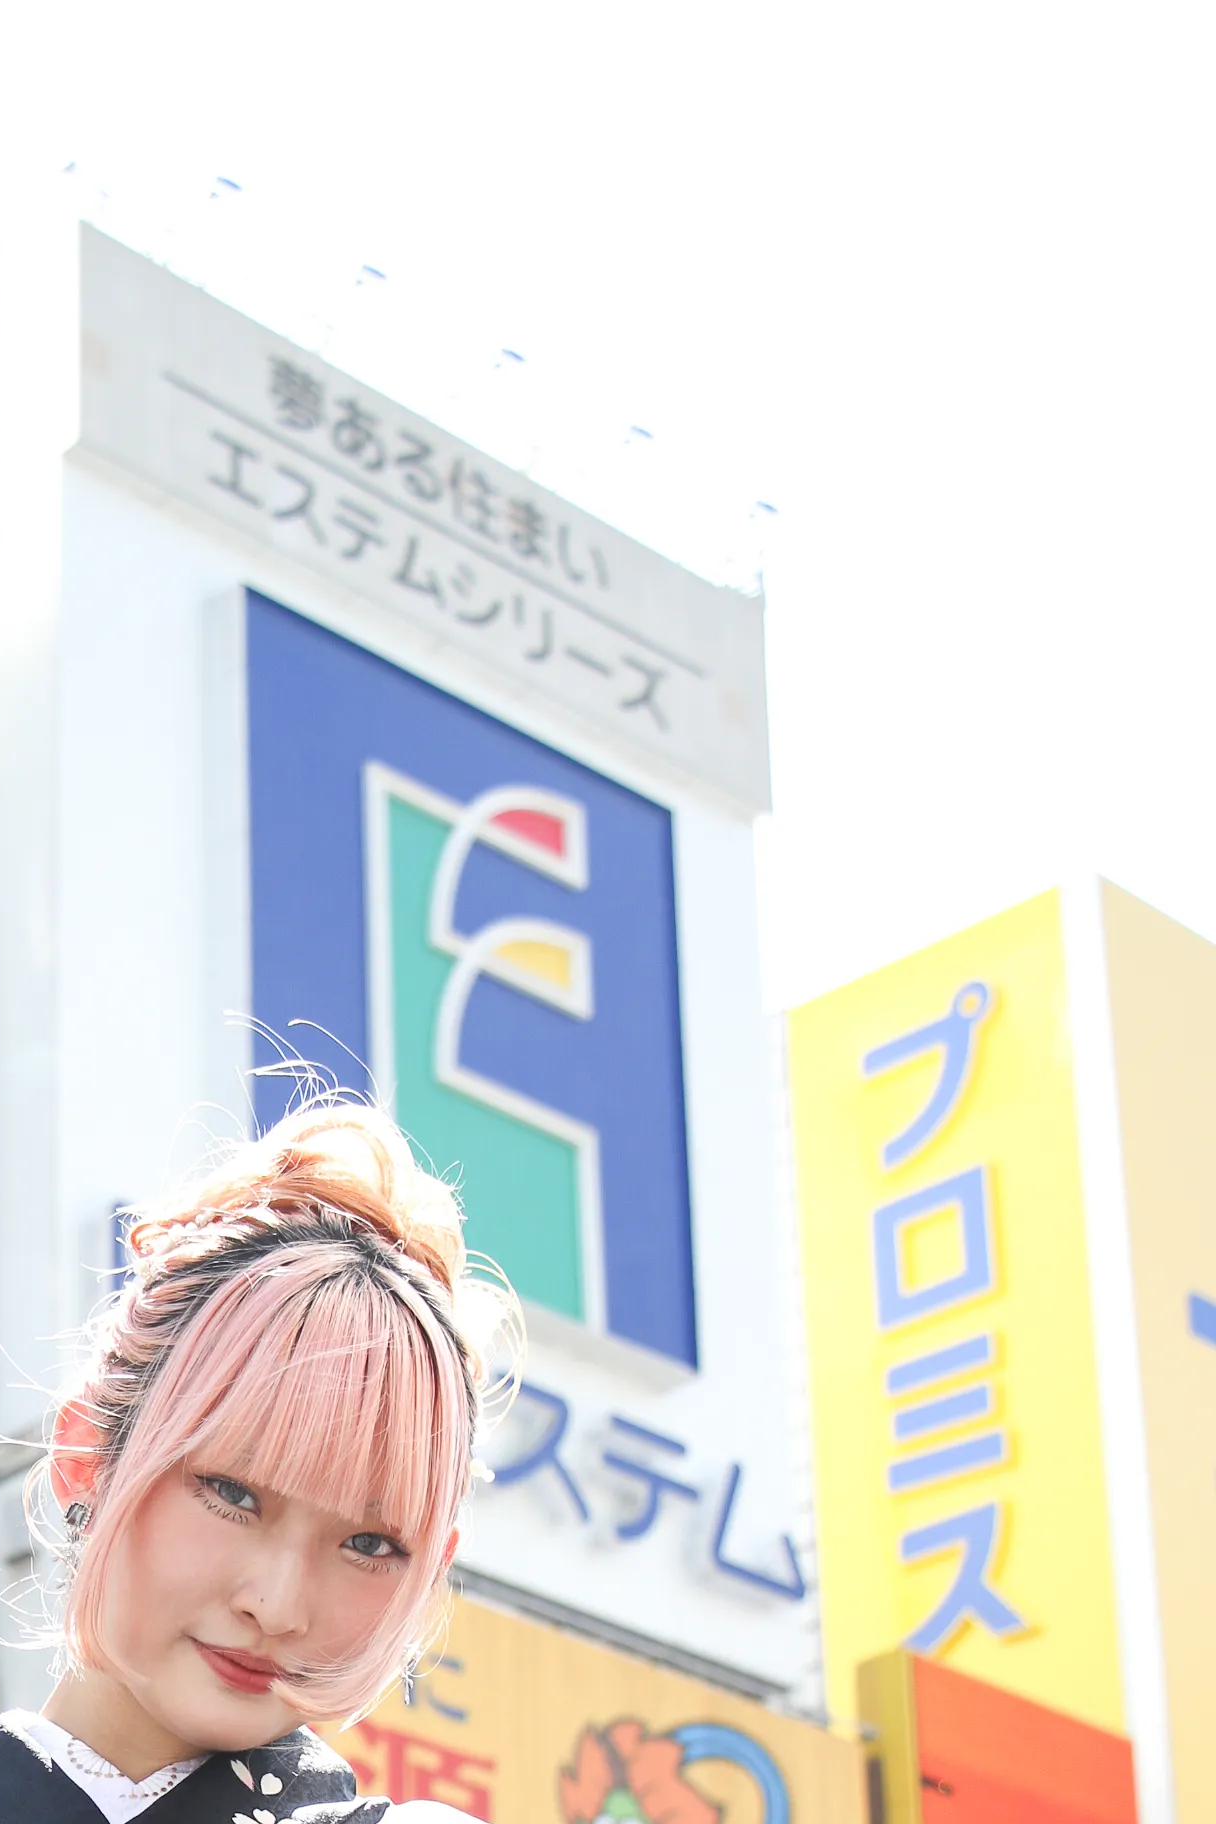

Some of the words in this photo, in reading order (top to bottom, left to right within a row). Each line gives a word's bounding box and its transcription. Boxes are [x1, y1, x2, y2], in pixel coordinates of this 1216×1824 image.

[268, 352, 612, 594] 夢ある住まい
[862, 980, 1026, 1654] プロミス
